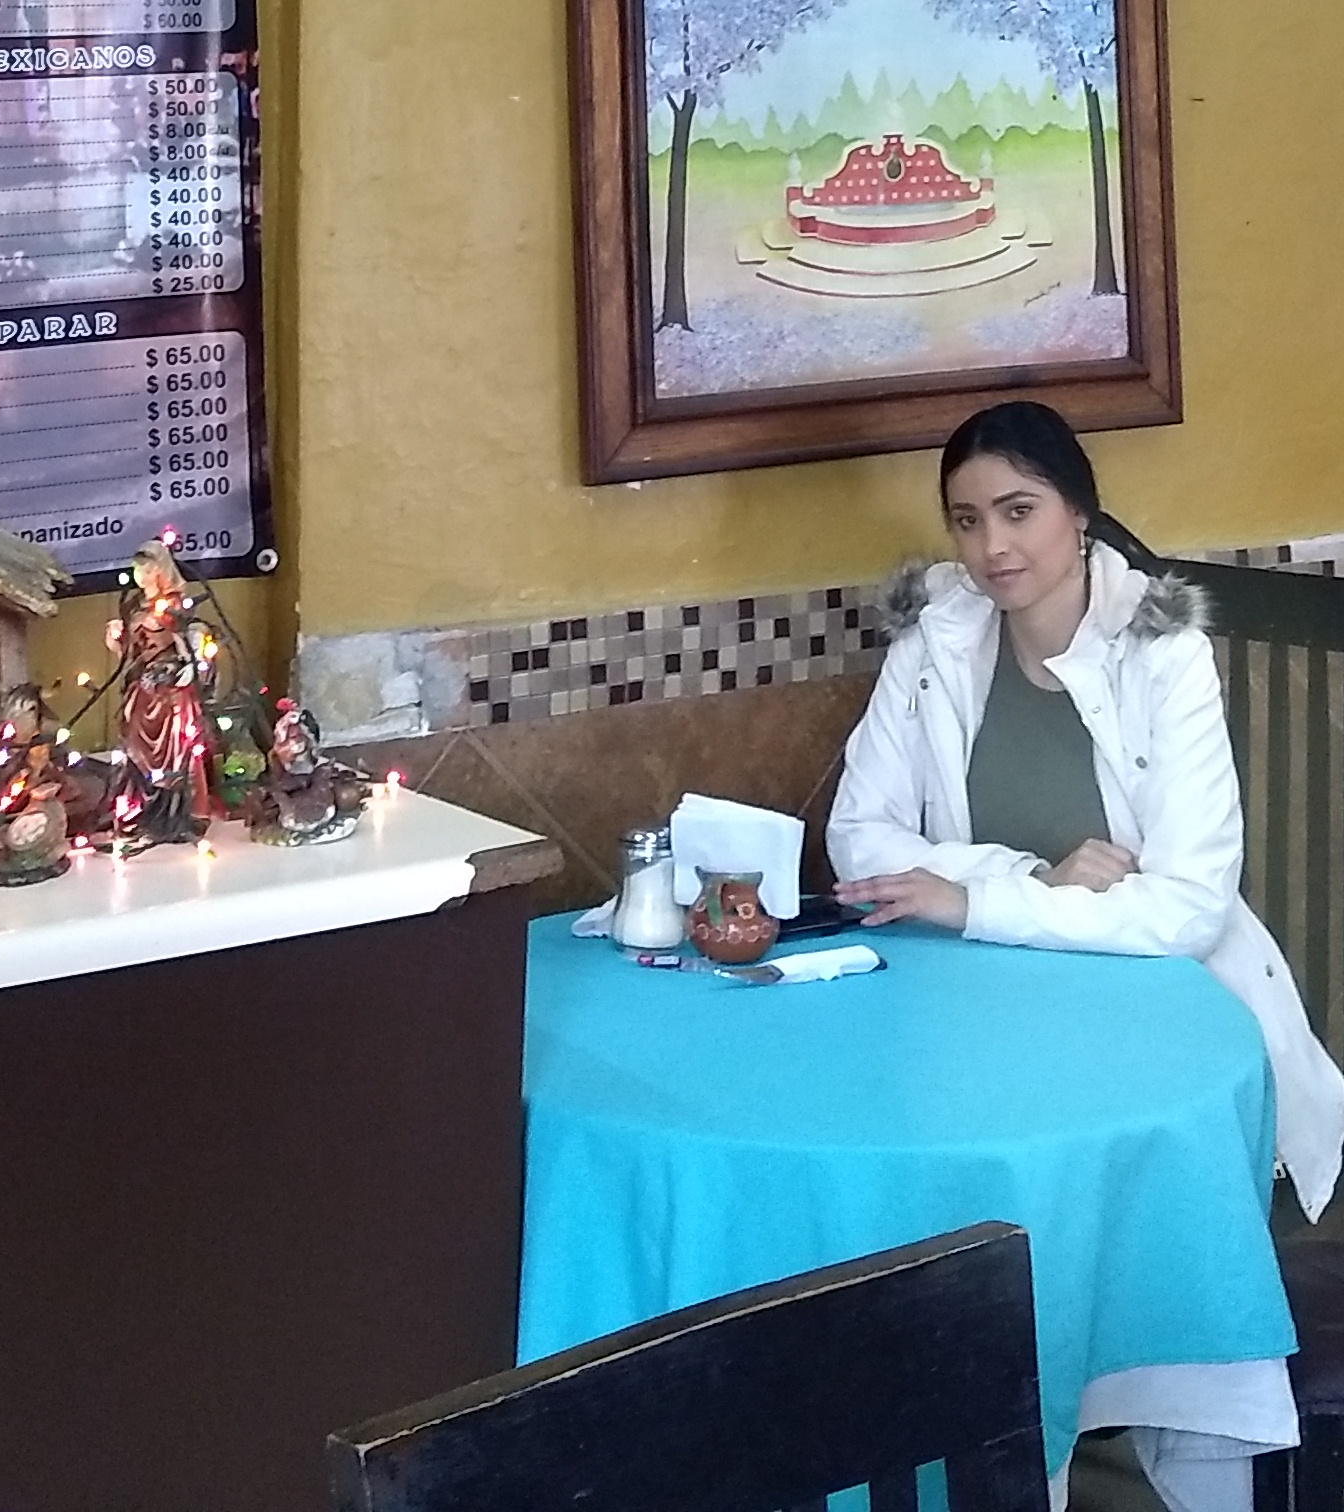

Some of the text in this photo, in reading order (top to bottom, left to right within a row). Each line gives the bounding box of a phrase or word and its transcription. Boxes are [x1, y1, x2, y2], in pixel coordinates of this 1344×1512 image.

[143, 13, 152, 29] $
[158, 12, 202, 28] 60.00
[148, 79, 158, 95] $
[165, 78, 217, 95] 50.00
[148, 102, 159, 118] $
[166, 100, 218, 117] 50.00
[149, 124, 159, 140] $
[149, 146, 159, 162] $
[149, 167, 160, 185] $
[167, 165, 221, 182] 40.00
[150, 189, 161, 206] $
[167, 186, 222, 204] 40.00
[150, 211, 162, 228] $
[168, 208, 222, 226] 40.00
[151, 233, 162, 250] $
[168, 230, 223, 248] 40.00
[152, 256, 163, 272] $
[169, 252, 223, 270] 40.00
[152, 277, 163, 294] $
[170, 274, 224, 292] 25.00
[146, 348, 158, 368] $
[166, 344, 225, 365] 65.00
[147, 375, 159, 394] $
[166, 370, 226, 392] 65.00
[147, 397, 227, 421] $ 65.00
[148, 423, 228, 448] $ 65.00
[149, 450, 229, 475] $ 65.00
[150, 476, 230, 501] $ 65.00
